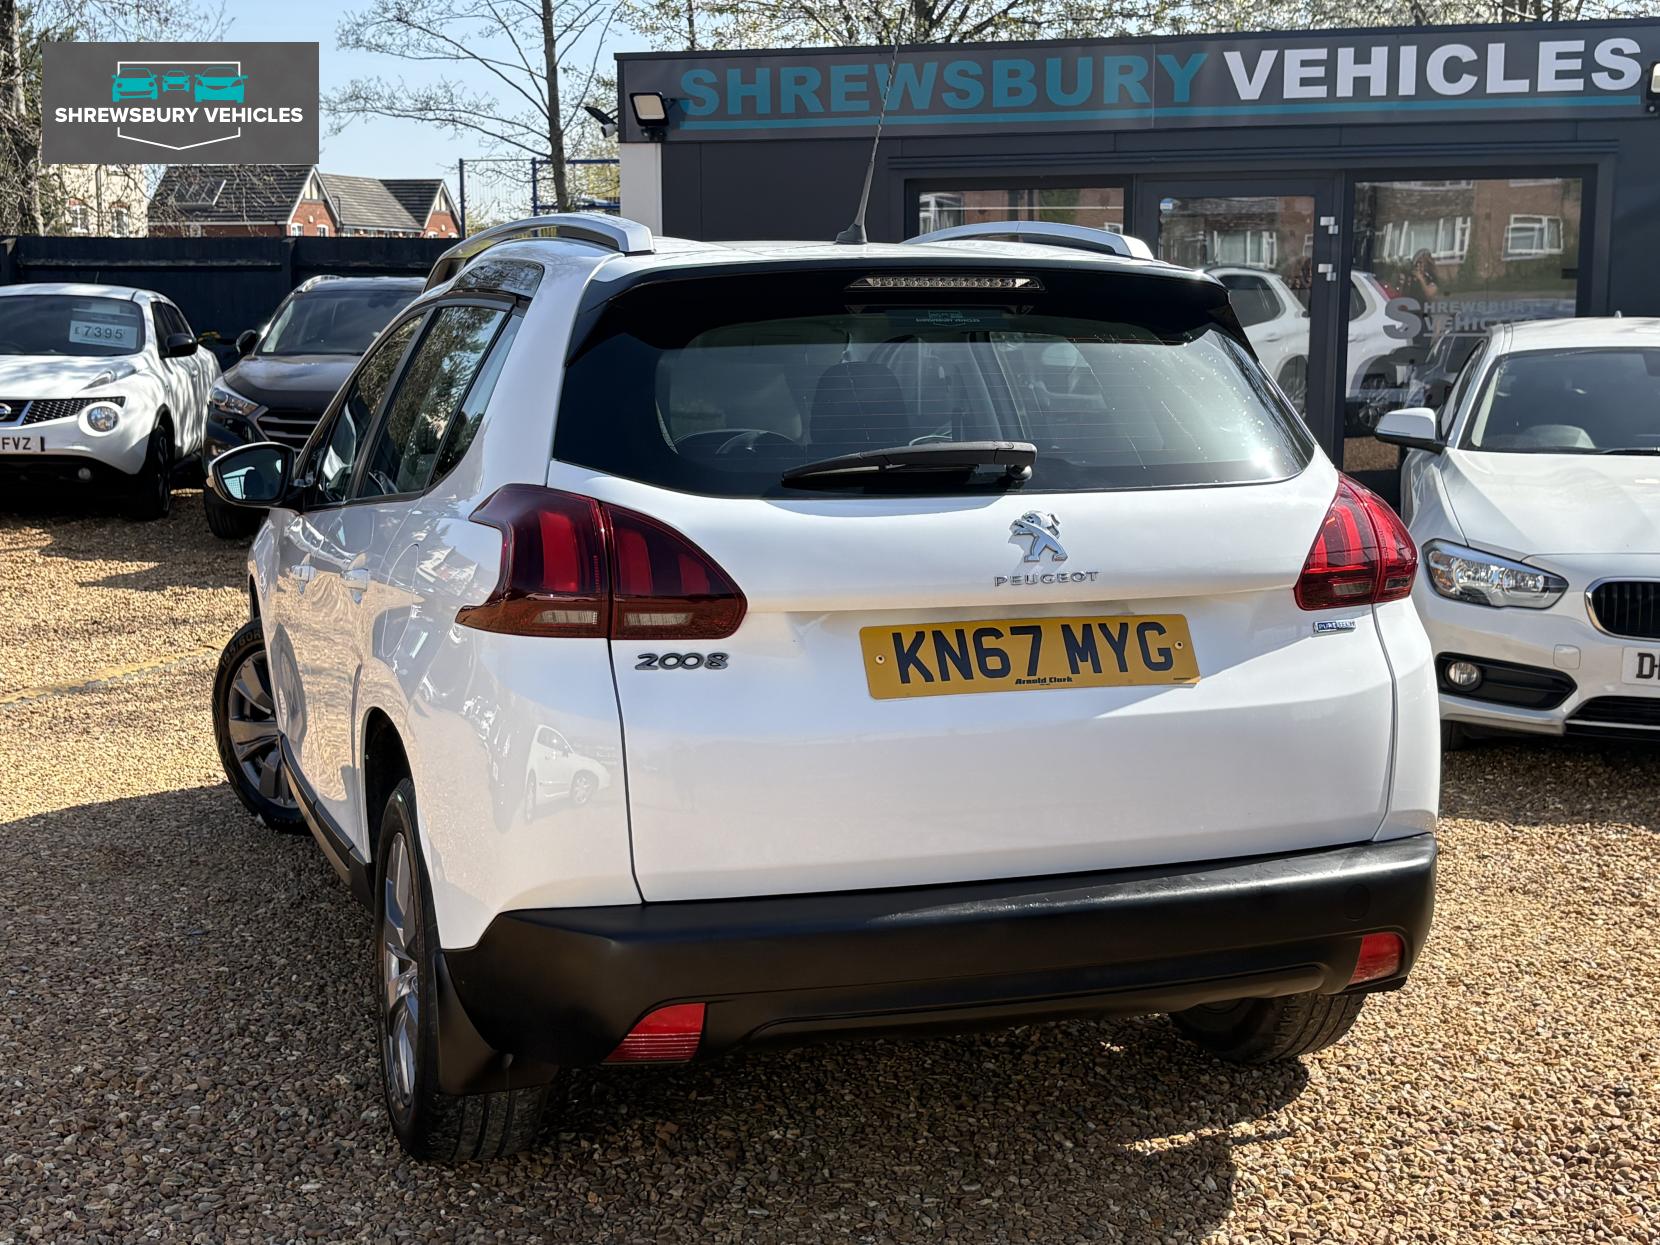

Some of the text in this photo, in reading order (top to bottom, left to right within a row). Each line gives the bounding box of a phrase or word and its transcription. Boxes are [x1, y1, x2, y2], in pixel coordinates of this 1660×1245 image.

[680, 37, 1642, 117] SHREWSBURY VEHICLES
[1, 436, 32, 451] FVZ
[994, 570, 1099, 588] PEUGEOT
[635, 652, 729, 671] 2008
[891, 621, 1175, 684] KN67 MYG
[1015, 677, 1047, 685] Arnold
